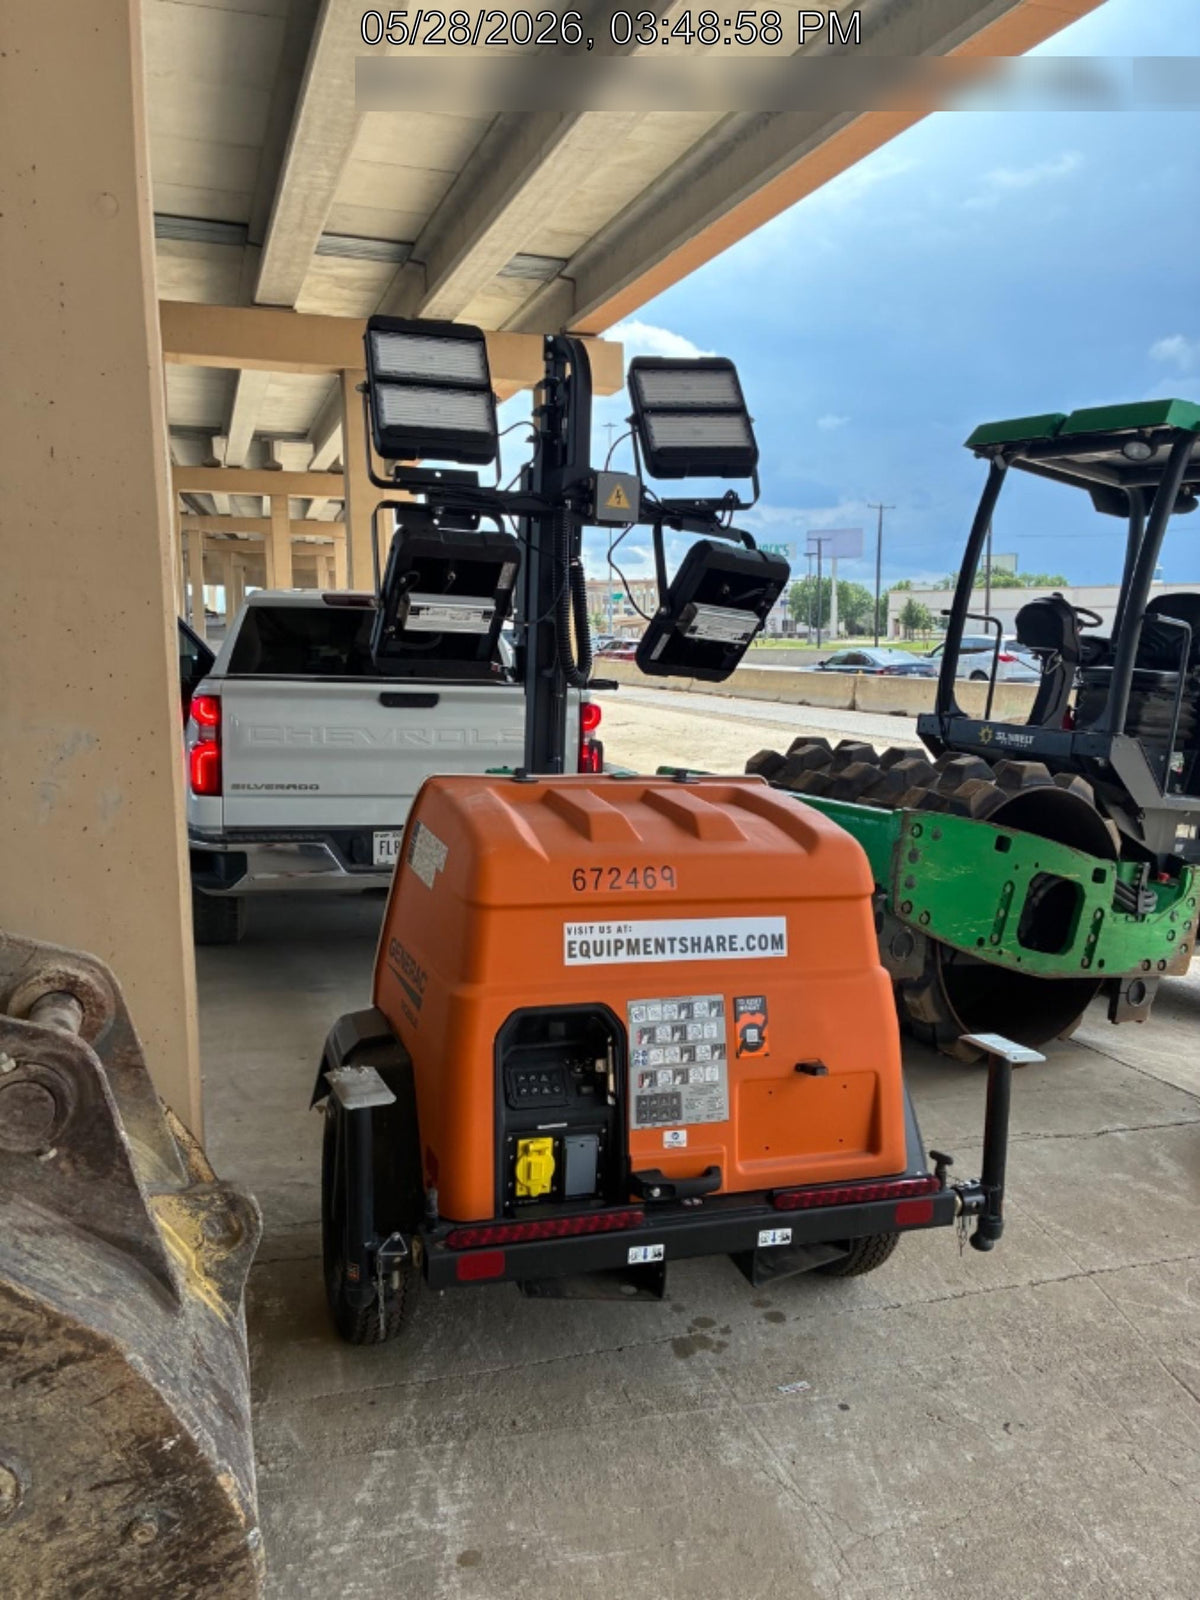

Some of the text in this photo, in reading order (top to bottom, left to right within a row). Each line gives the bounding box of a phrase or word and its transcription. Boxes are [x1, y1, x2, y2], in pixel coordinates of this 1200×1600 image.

[248, 725, 524, 745] CHEVROLE
[572, 865, 675, 891] 672469
[567, 924, 632, 936] VISIT US AT:
[567, 933, 784, 960] EQUIPMENTSHARE.COM
